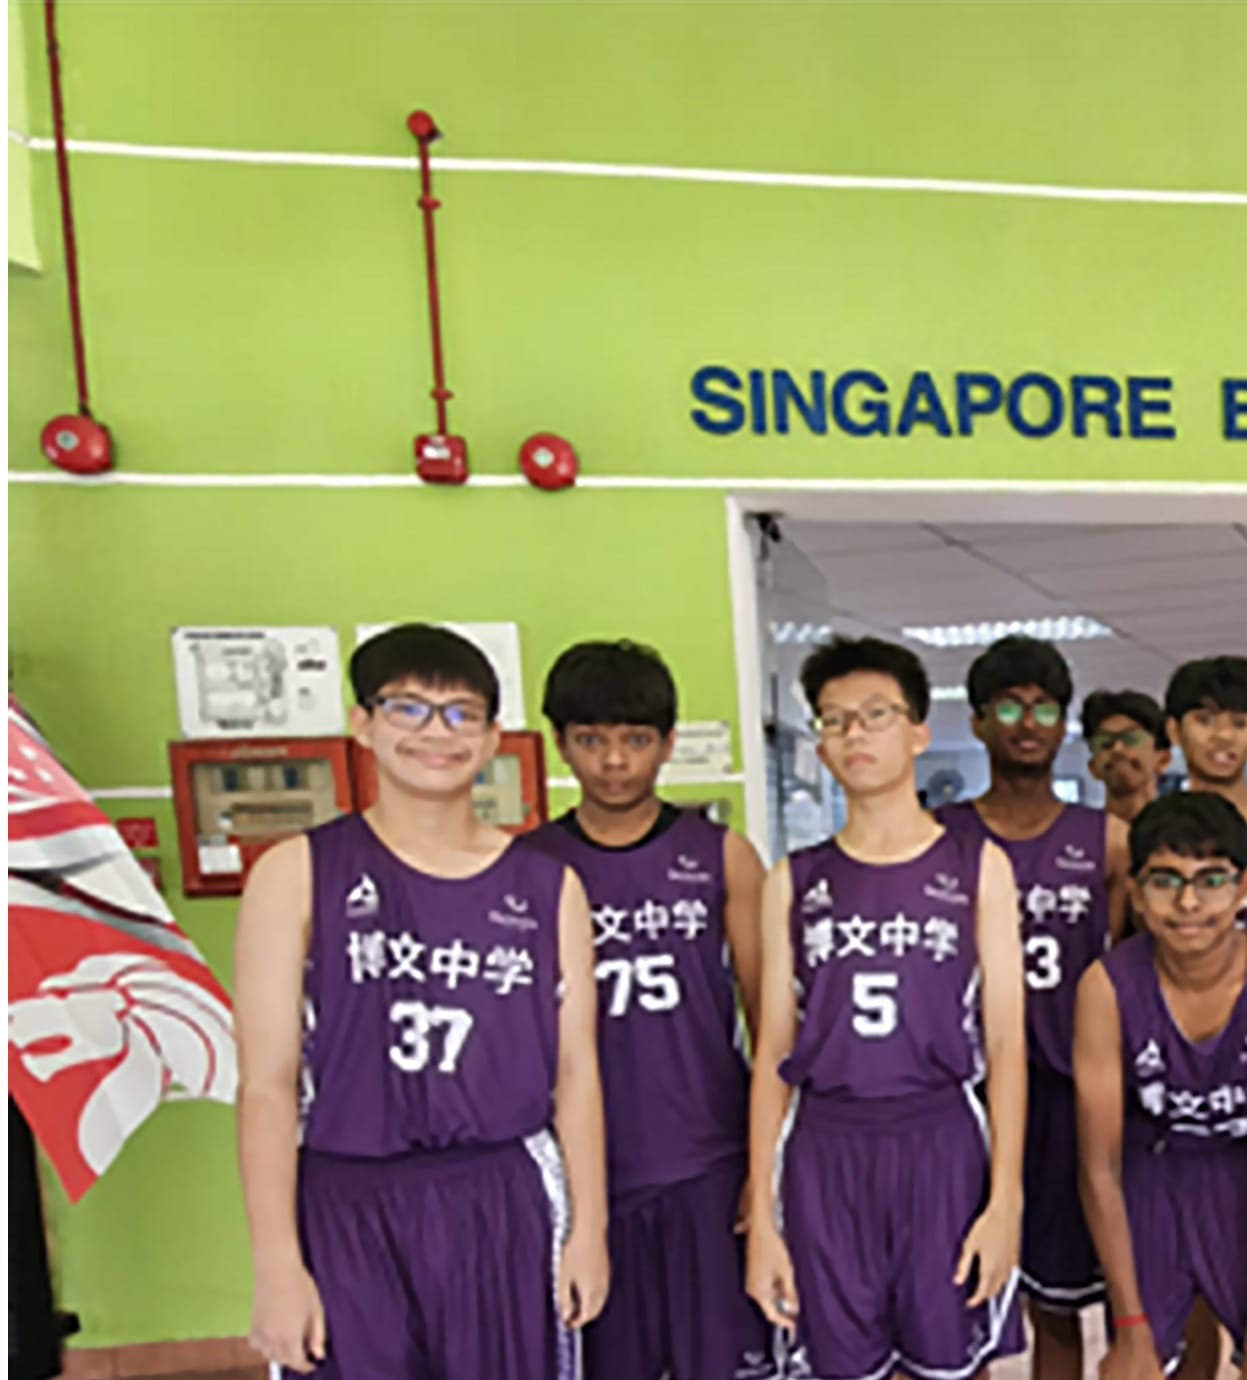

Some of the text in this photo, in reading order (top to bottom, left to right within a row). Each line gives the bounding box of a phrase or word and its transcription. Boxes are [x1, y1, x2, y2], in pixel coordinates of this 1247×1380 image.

[690, 365, 1176, 439] SINGAPORE
[347, 931, 534, 994] 博文中学
[594, 954, 680, 1016] 75
[388, 1001, 474, 1072] 37
[852, 973, 898, 1037] 5
